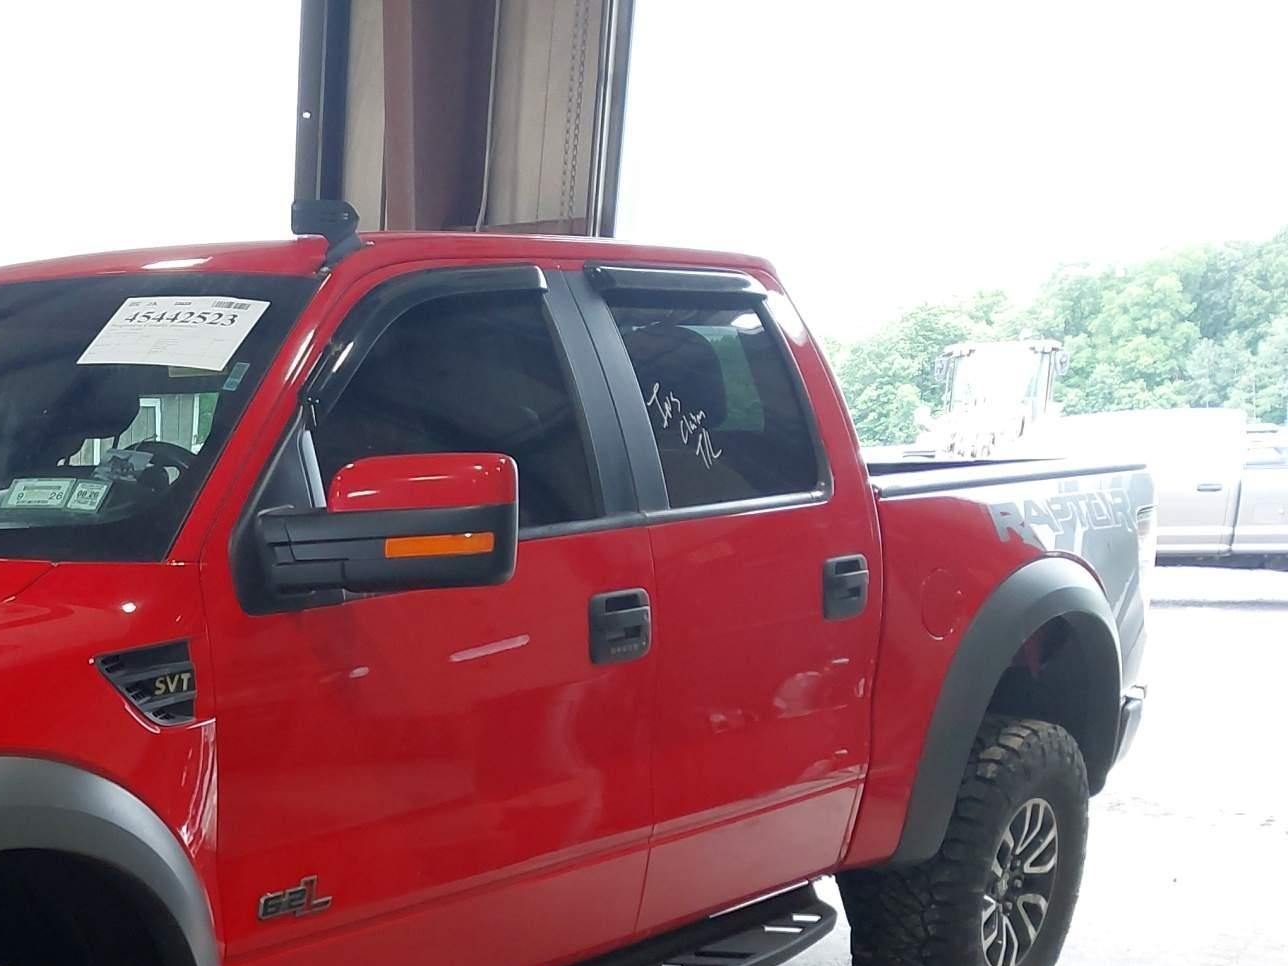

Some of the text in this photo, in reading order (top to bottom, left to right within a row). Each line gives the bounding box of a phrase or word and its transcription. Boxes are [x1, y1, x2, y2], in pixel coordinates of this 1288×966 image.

[125, 311, 239, 327] 45442523
[48, 491, 64, 501] 26
[988, 487, 1139, 549] RAPTOR
[154, 672, 191, 696] SVT
